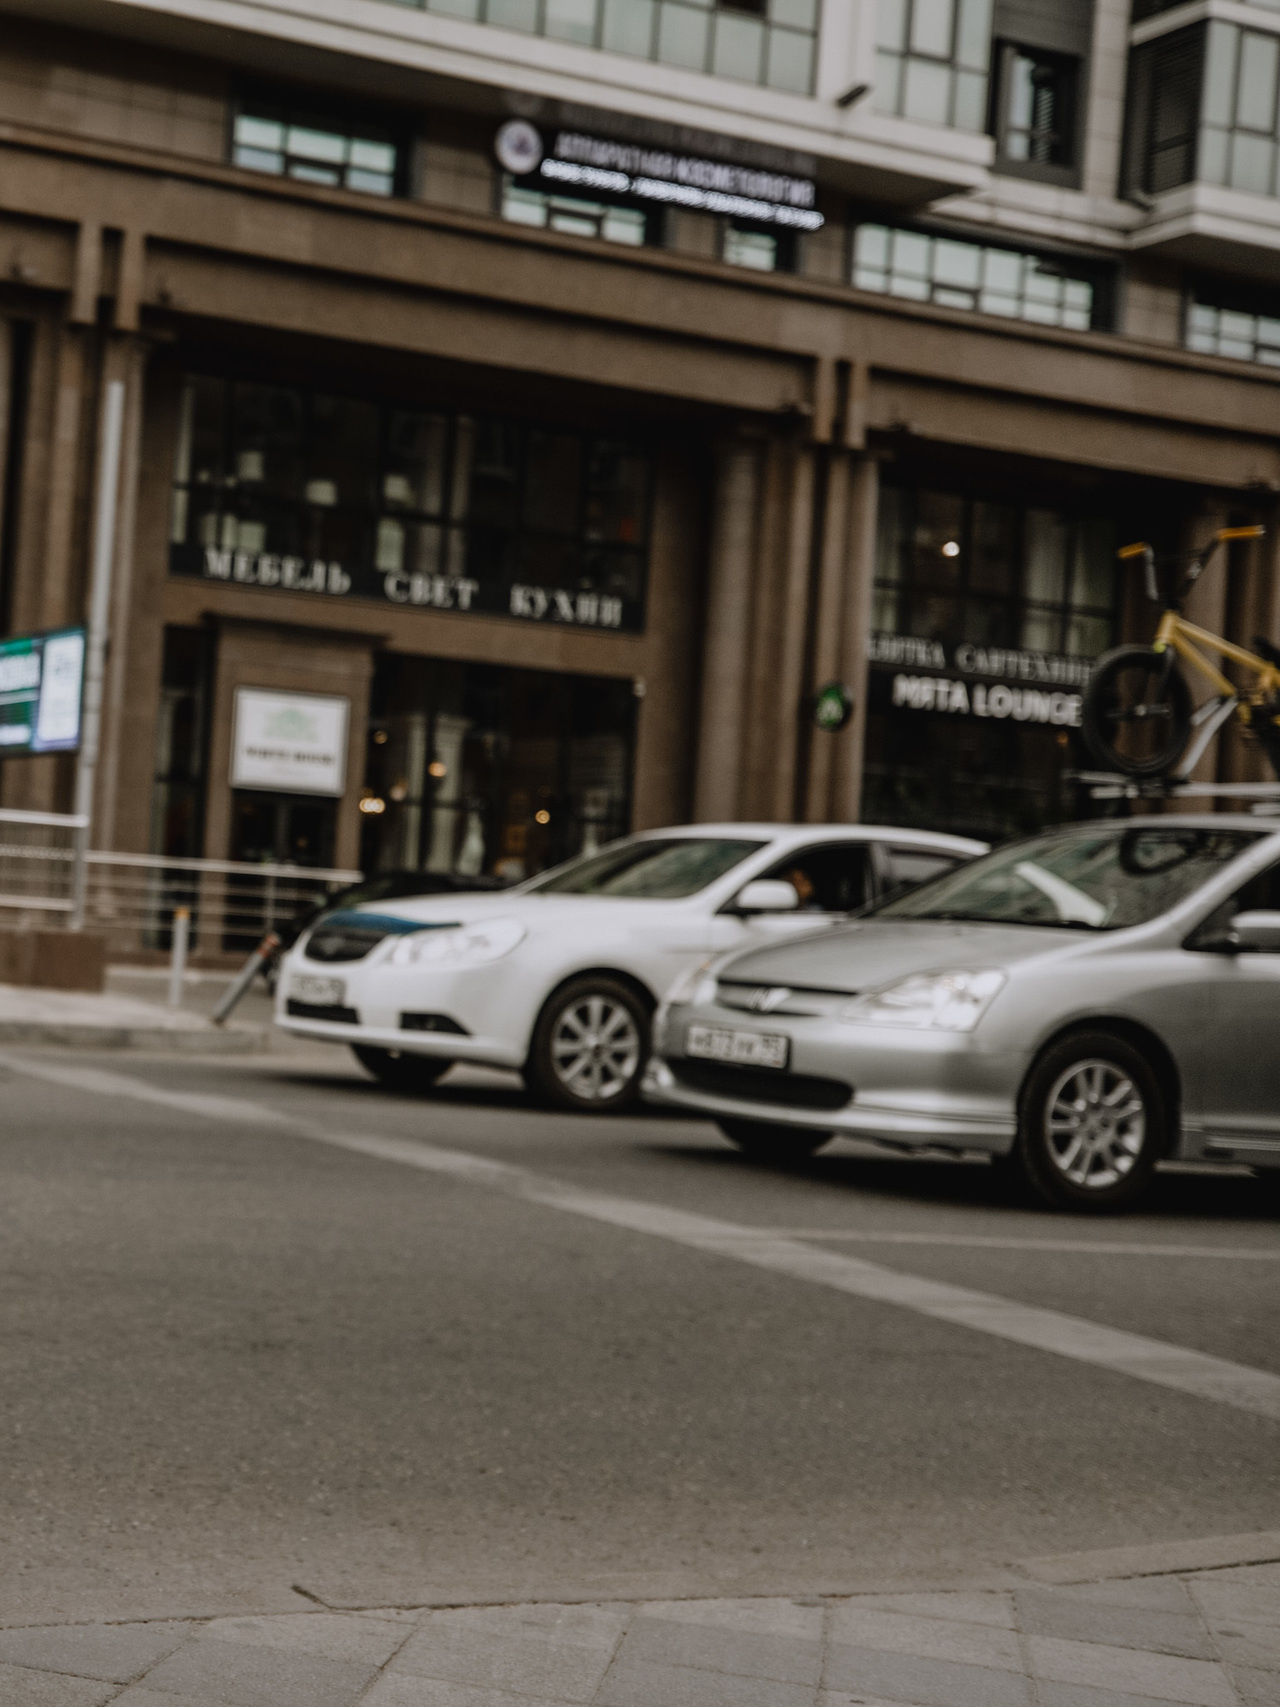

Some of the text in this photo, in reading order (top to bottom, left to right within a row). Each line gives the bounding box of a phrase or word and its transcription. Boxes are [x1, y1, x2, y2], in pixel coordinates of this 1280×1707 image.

[204, 546, 622, 628] МЕБЕЛЬ СВЕТ КУХНИ
[893, 674, 1084, 727] МЯТА LOUNGE
